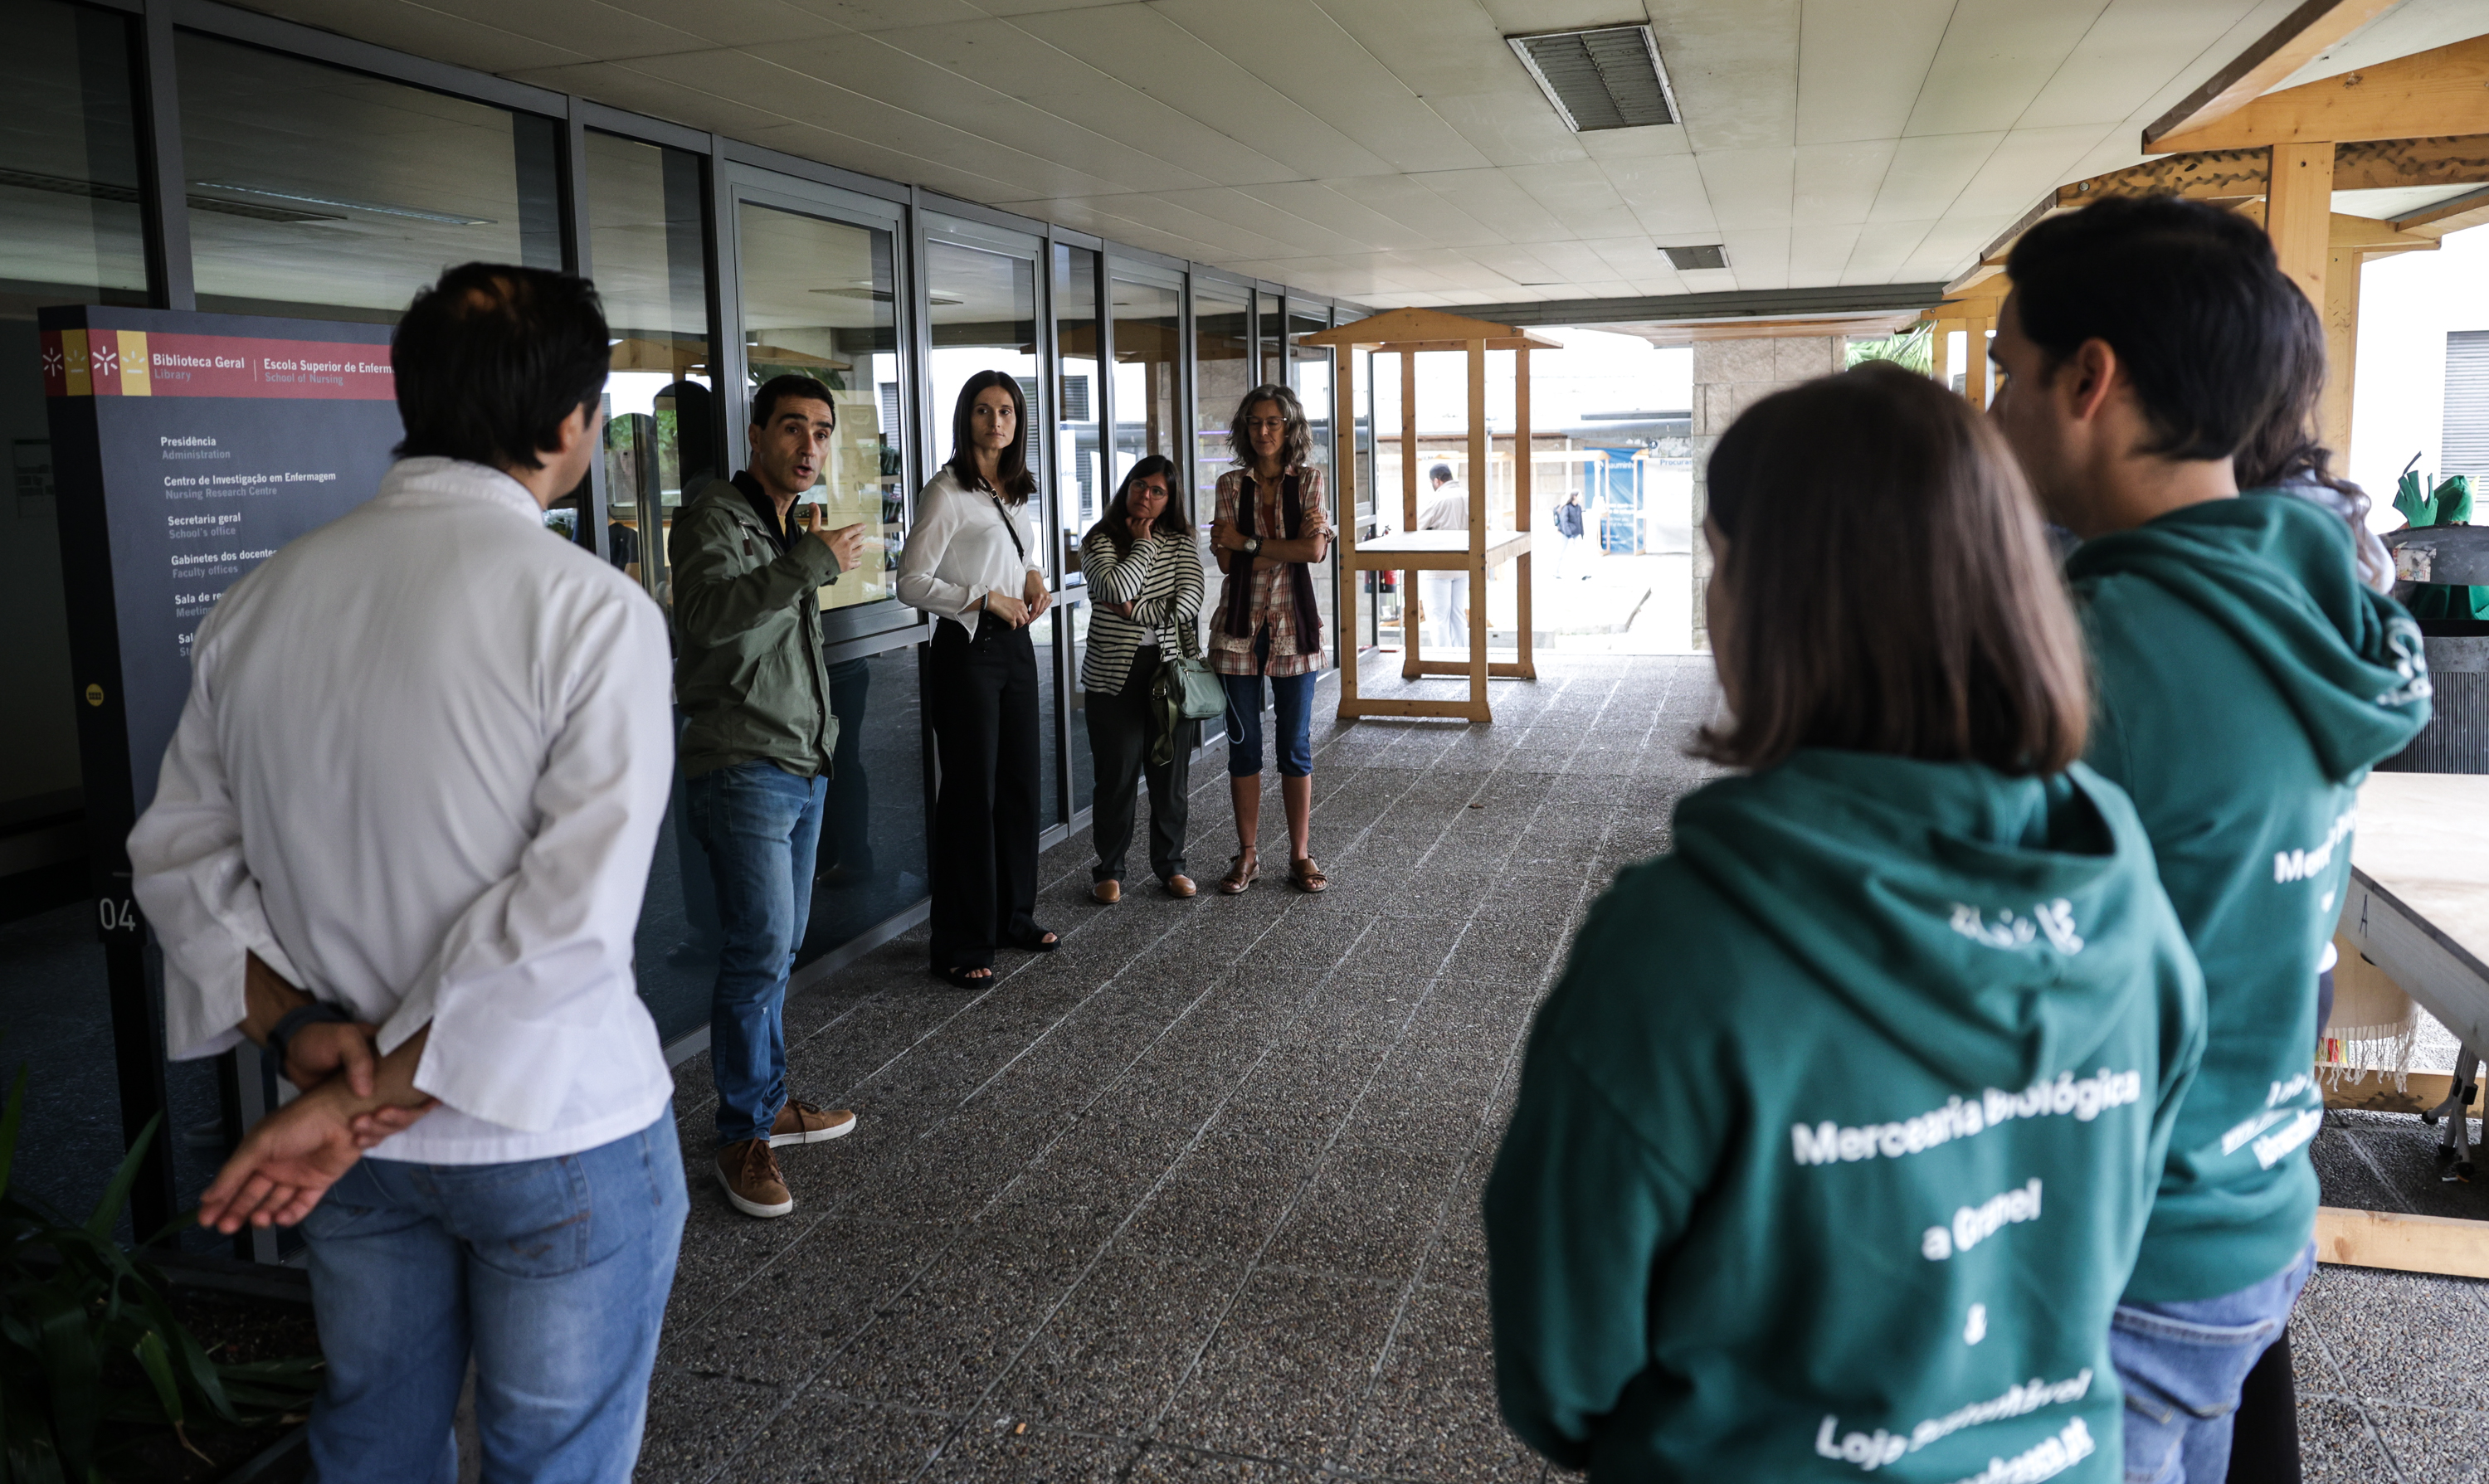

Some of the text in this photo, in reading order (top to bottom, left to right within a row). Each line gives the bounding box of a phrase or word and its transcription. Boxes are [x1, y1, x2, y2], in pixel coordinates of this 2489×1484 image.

[153, 353, 245, 368] Biblioteca Geral
[264, 358, 297, 371] Escola
[300, 359, 341, 373] Superior
[344, 362, 356, 372] de
[154, 368, 191, 382] Library
[265, 372, 343, 387] School of Nursing
[161, 436, 217, 446] Presidência
[162, 450, 231, 460] Administration
[164, 476, 196, 486] Centro
[198, 475, 210, 484] de
[212, 474, 267, 485] Investigação
[285, 472, 336, 483] Enfermagem
[166, 486, 277, 500] Nursing Research Centre
[168, 512, 241, 526] Secretaria geral
[169, 526, 236, 539] School's office
[171, 553, 218, 566] Gabinetes
[221, 552, 236, 561] dos
[173, 564, 238, 578] Faculty offices
[174, 593, 196, 605] Sala
[198, 592, 210, 602] de
[178, 633, 194, 644] Sal
[180, 647, 191, 657] St
[99, 898, 137, 932] 04
[1791, 1094, 1984, 1166] Mercearia
[1921, 1224, 1953, 1262] a
[1815, 1413, 1908, 1472] Loja
